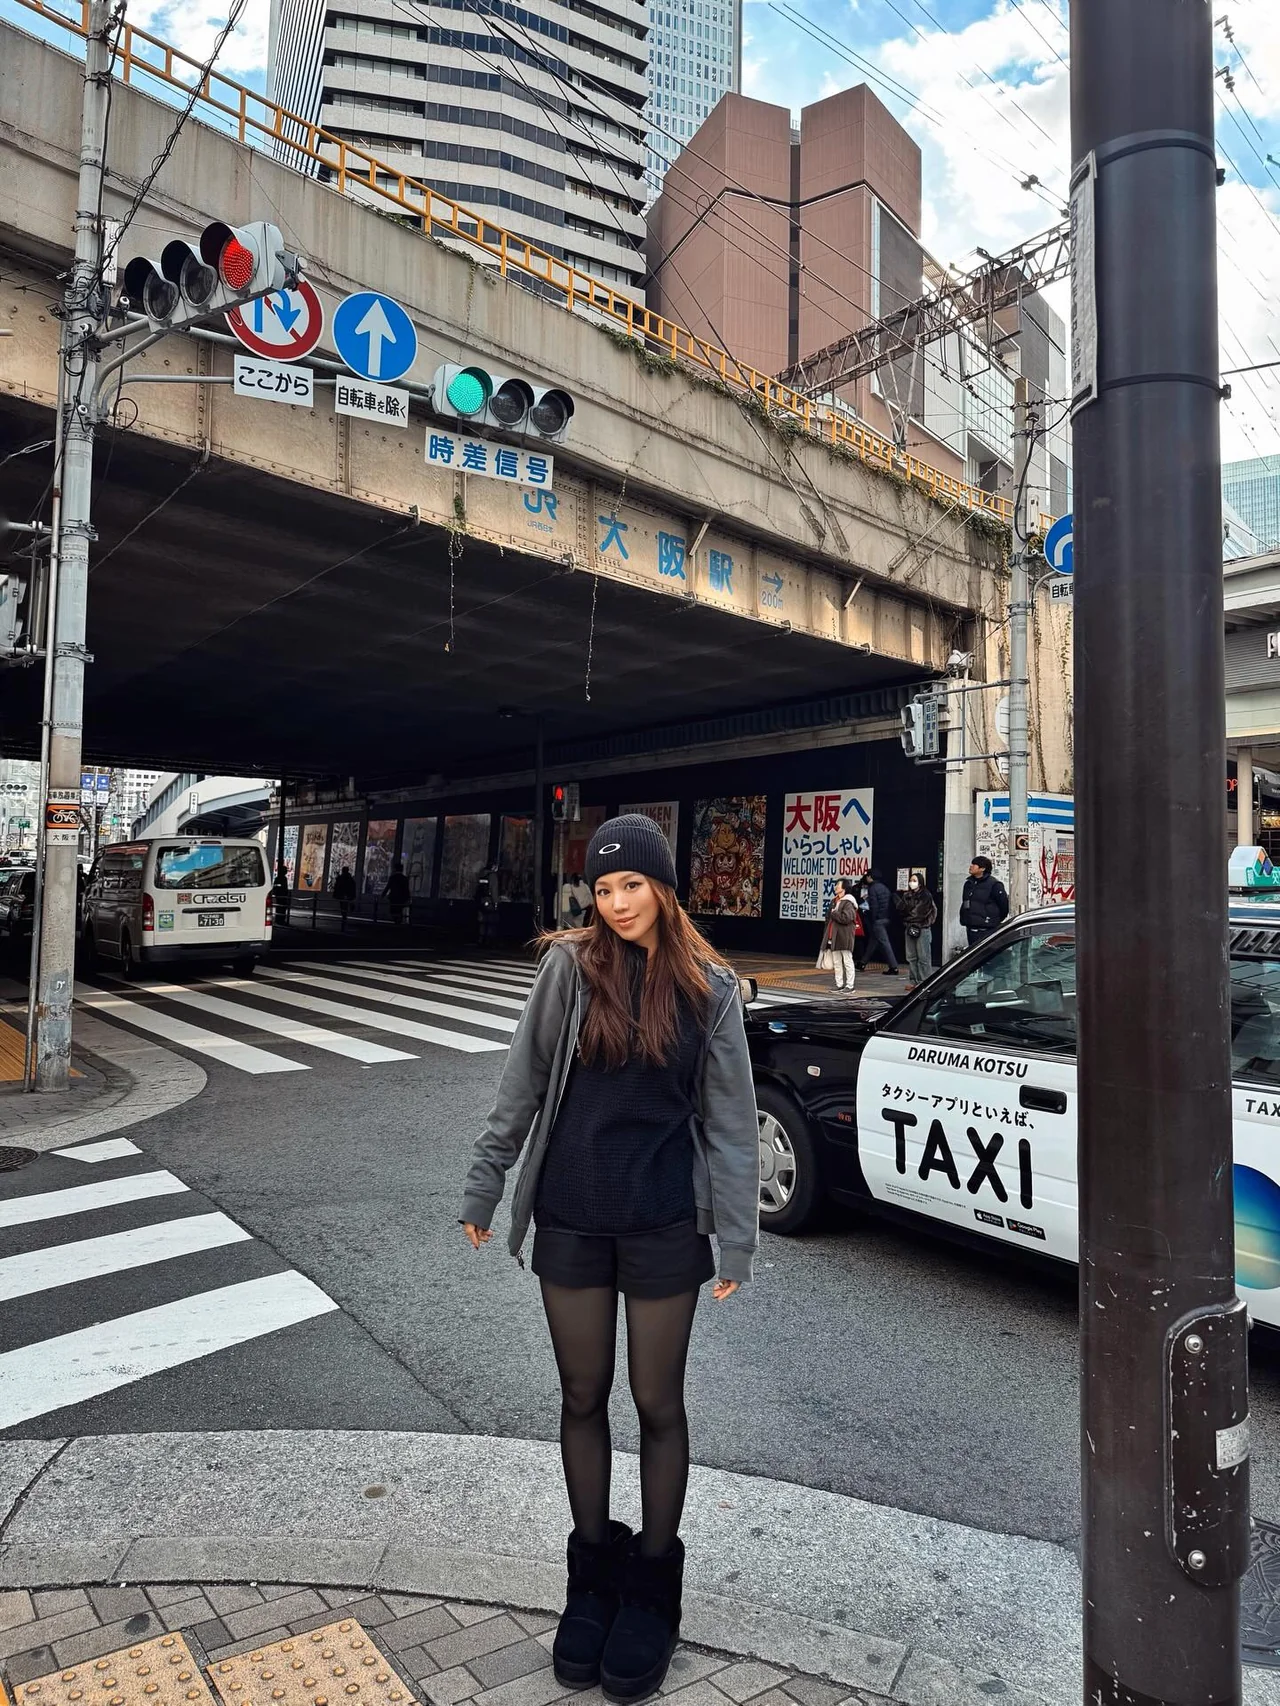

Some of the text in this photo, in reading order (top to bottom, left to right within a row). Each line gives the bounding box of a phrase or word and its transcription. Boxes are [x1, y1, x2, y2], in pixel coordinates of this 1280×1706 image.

[238, 366, 310, 397] ここから
[337, 385, 407, 420] 自転車を除く
[429, 434, 549, 484] 時差信号
[523, 488, 557, 521] JR
[761, 590, 784, 610] 200m
[785, 795, 871, 833] 大阪へ
[784, 834, 870, 856] いらっしゃい
[784, 857, 868, 875] WELCOME TO OSAKA
[782, 878, 818, 890] 오사카에
[782, 891, 798, 904] 오신
[781, 904, 818, 918] 환영합니다
[907, 1047, 1029, 1078] DARUMA KOTSU
[882, 1083, 1036, 1130] タクシーアプリといえば、
[881, 1107, 1033, 1210] TAXI
